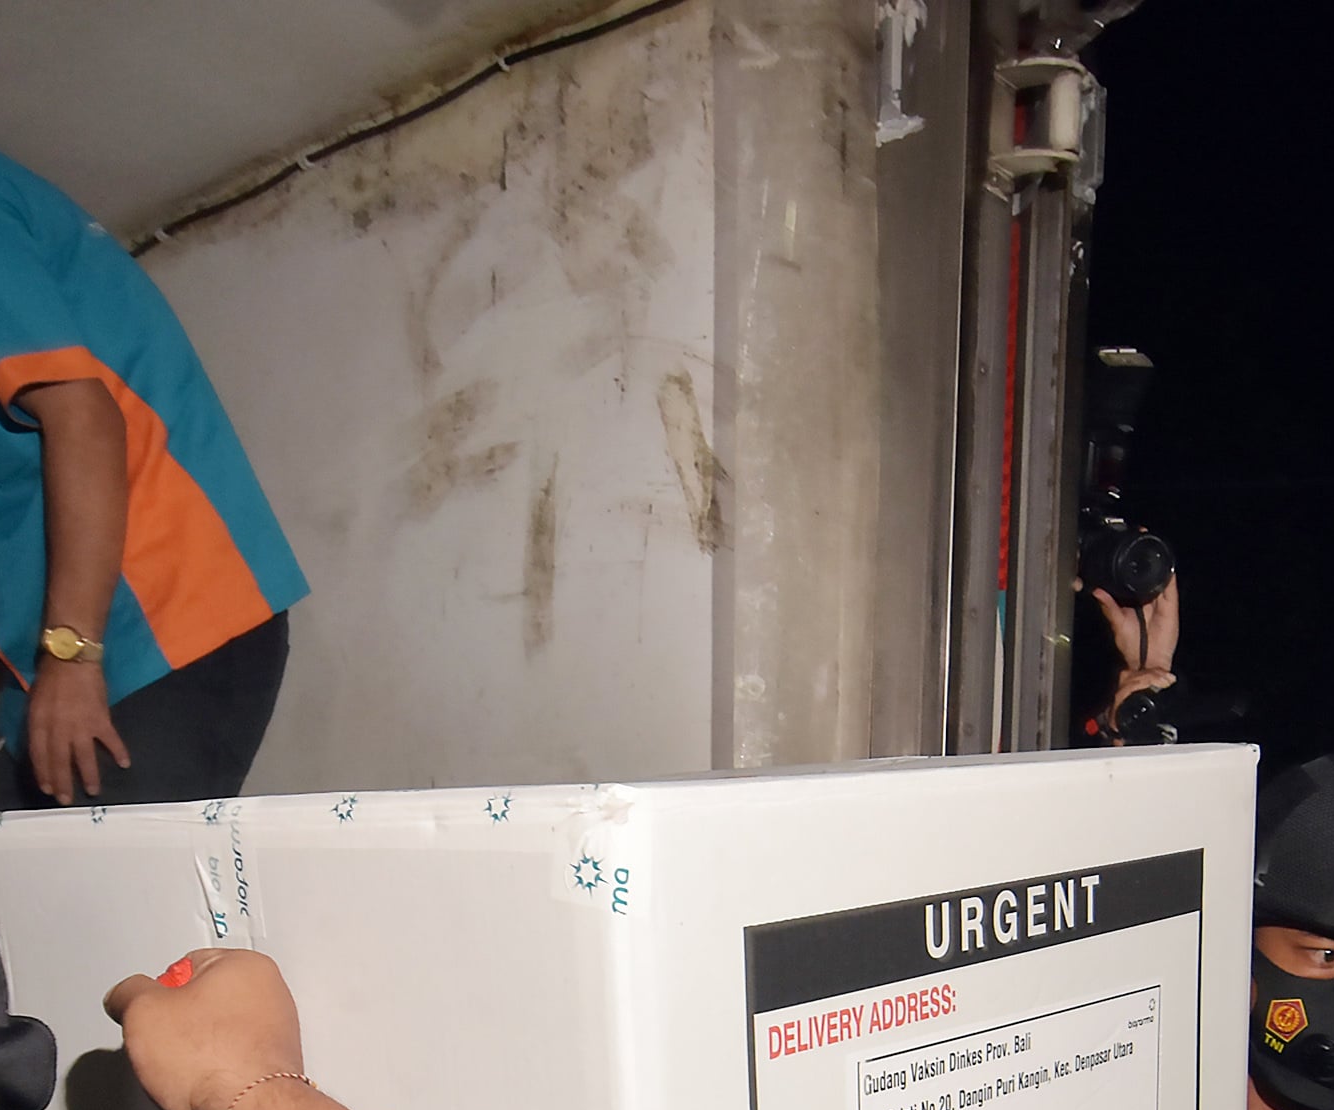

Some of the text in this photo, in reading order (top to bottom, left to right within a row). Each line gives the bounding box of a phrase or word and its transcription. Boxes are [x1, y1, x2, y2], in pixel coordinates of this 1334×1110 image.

[925, 874, 1100, 959] URGENT
[768, 984, 956, 1060] DELIVERY ADDRESS:
[864, 1032, 1032, 1096] Gudang Vaksin Dinkes Prov. Bali
[959, 1083, 993, 1109] Dangin
[996, 1074, 1015, 1097] Puri
[1018, 1066, 1051, 1090] Kangin,
[1054, 1060, 1072, 1079] Kec.
[1075, 1048, 1112, 1072] Denpasar
[1113, 1041, 1134, 1060] Utara
